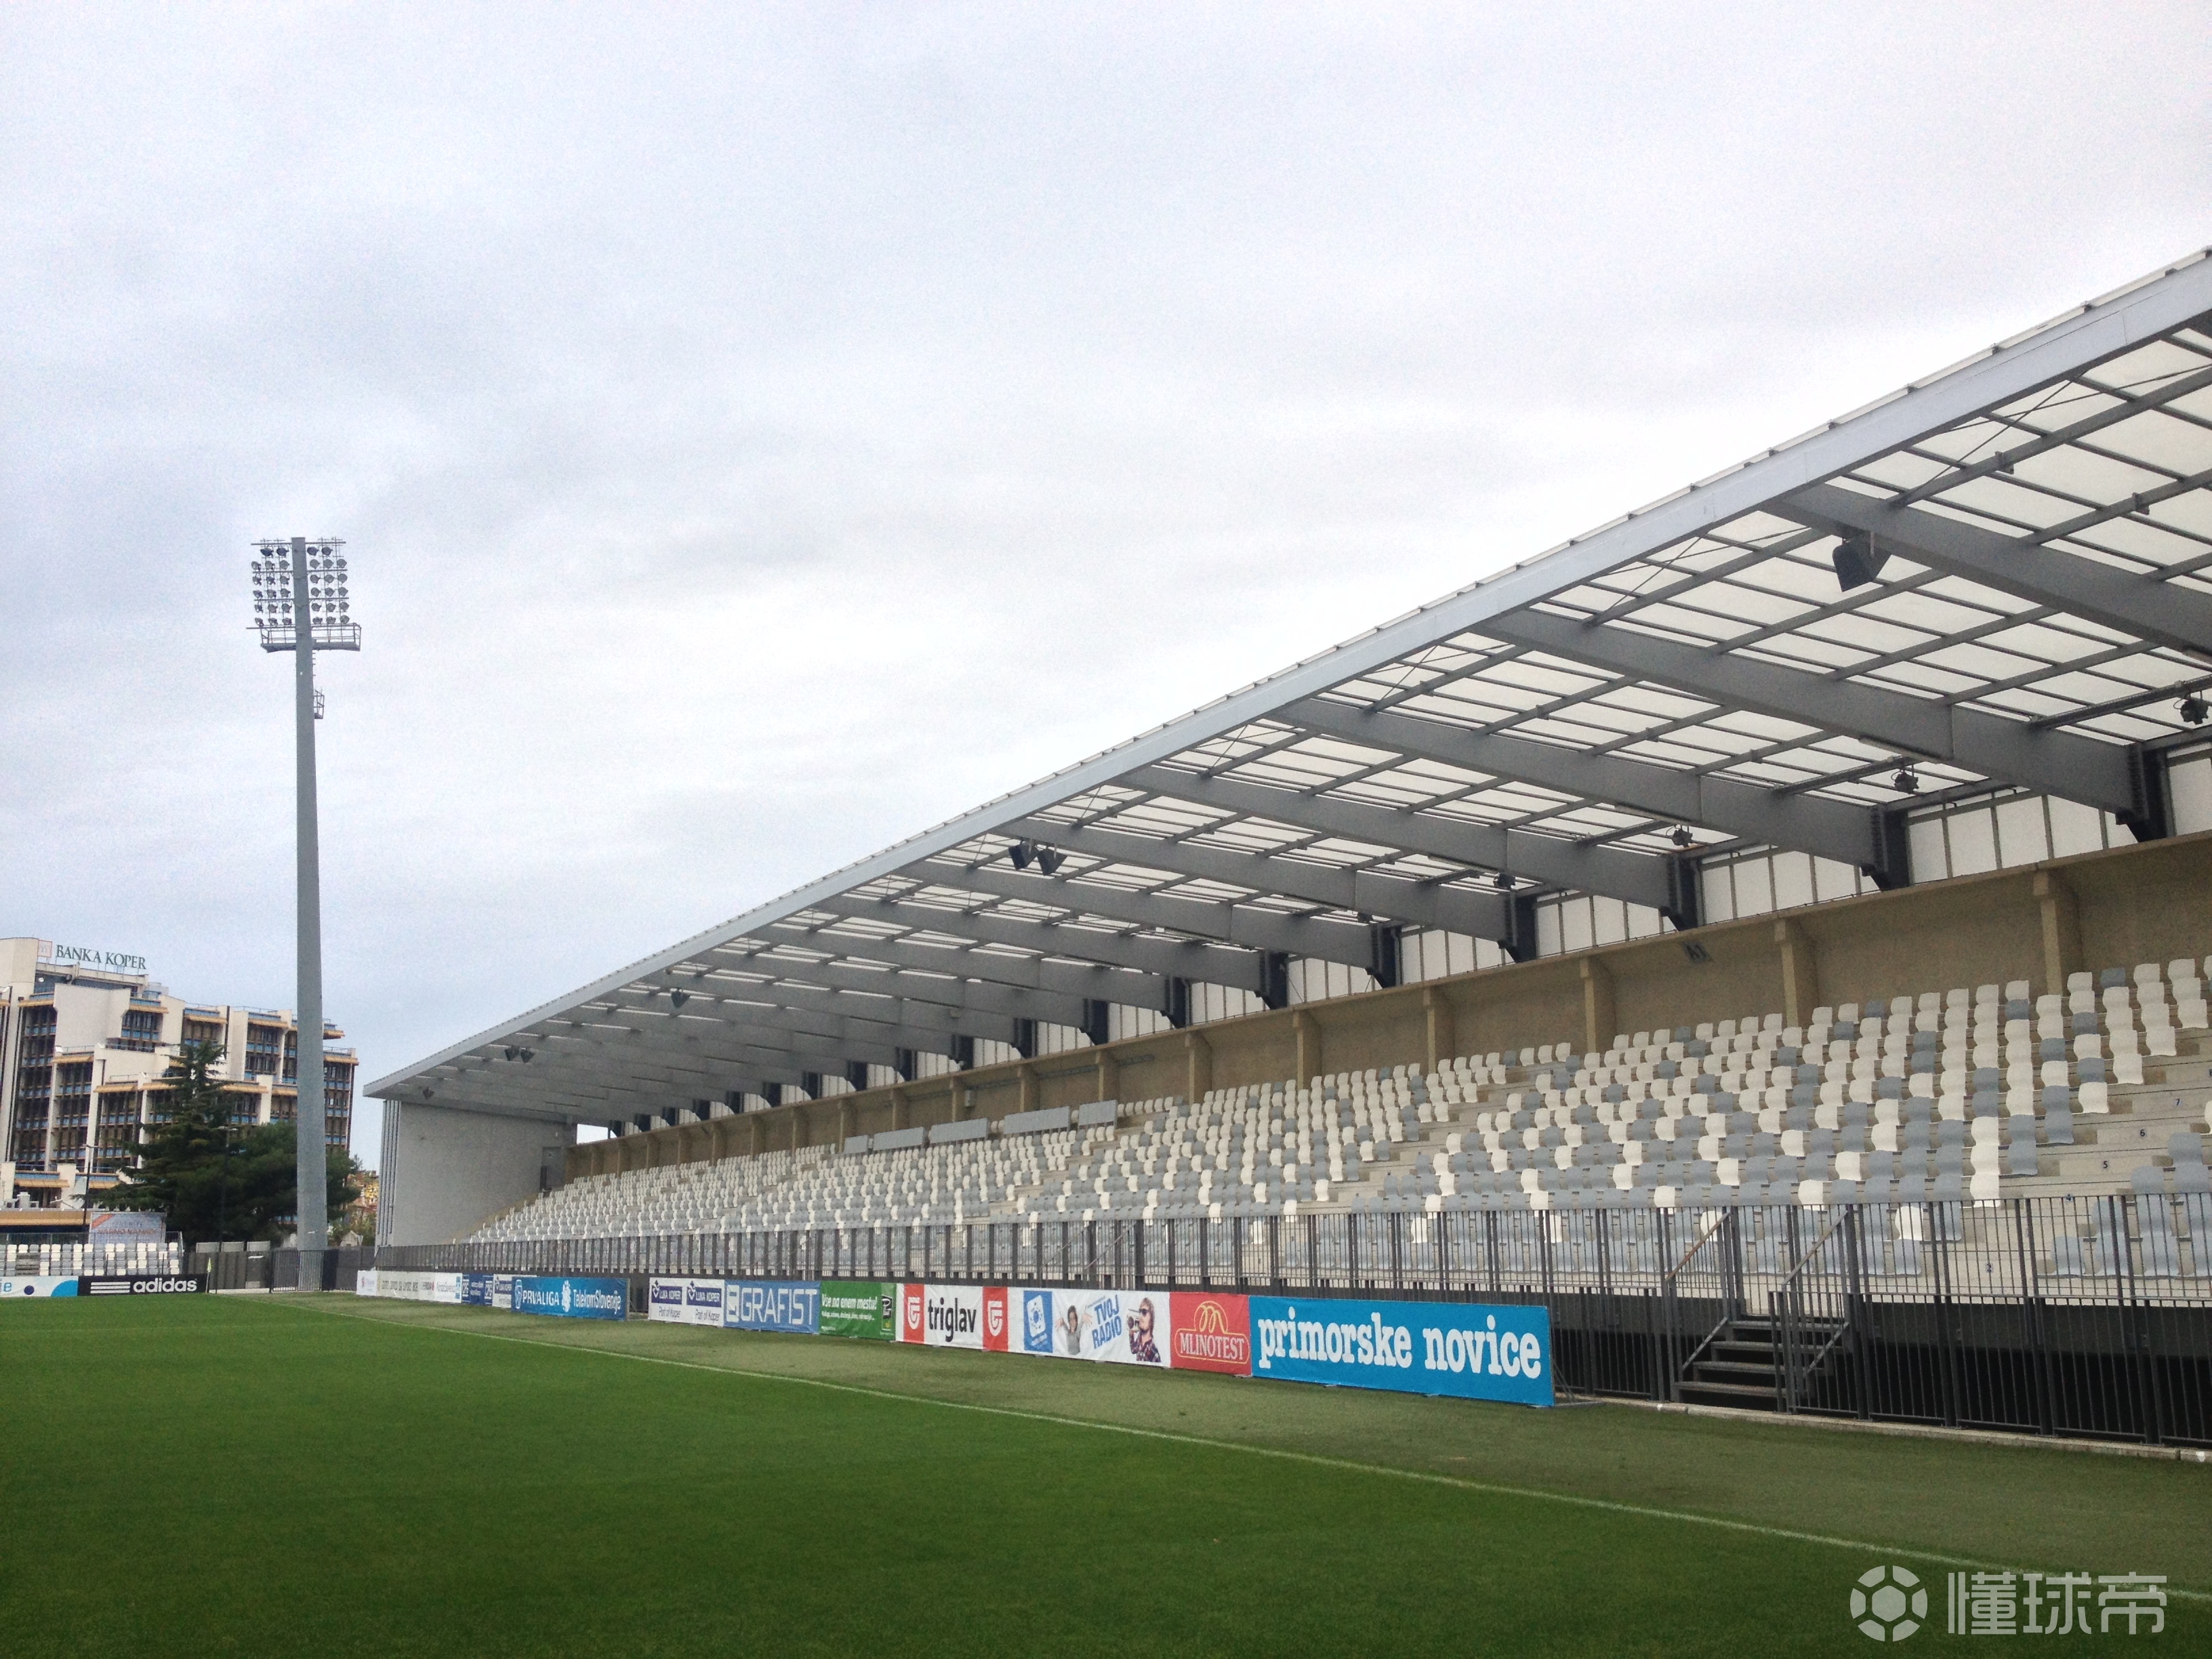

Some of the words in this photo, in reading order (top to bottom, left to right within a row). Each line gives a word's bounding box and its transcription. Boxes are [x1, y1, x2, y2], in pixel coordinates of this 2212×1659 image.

[56, 945, 101, 963] BANKA
[106, 952, 146, 969] KOPER
[133, 1277, 197, 1292] adidas
[523, 1290, 560, 1306] PRVALIGA
[669, 1290, 681, 1300] KOPER
[695, 1292, 705, 1300] LUKA
[707, 1292, 720, 1302] KOPER
[741, 1288, 817, 1325] GRAFIST
[928, 1297, 977, 1343] triglav
[1094, 1294, 1119, 1324] TVOJ
[1092, 1315, 1122, 1349] RADIO
[1180, 1332, 1244, 1360] MLINOTEST
[1258, 1307, 1412, 1369] primorske
[1422, 1315, 1541, 1379] novice
